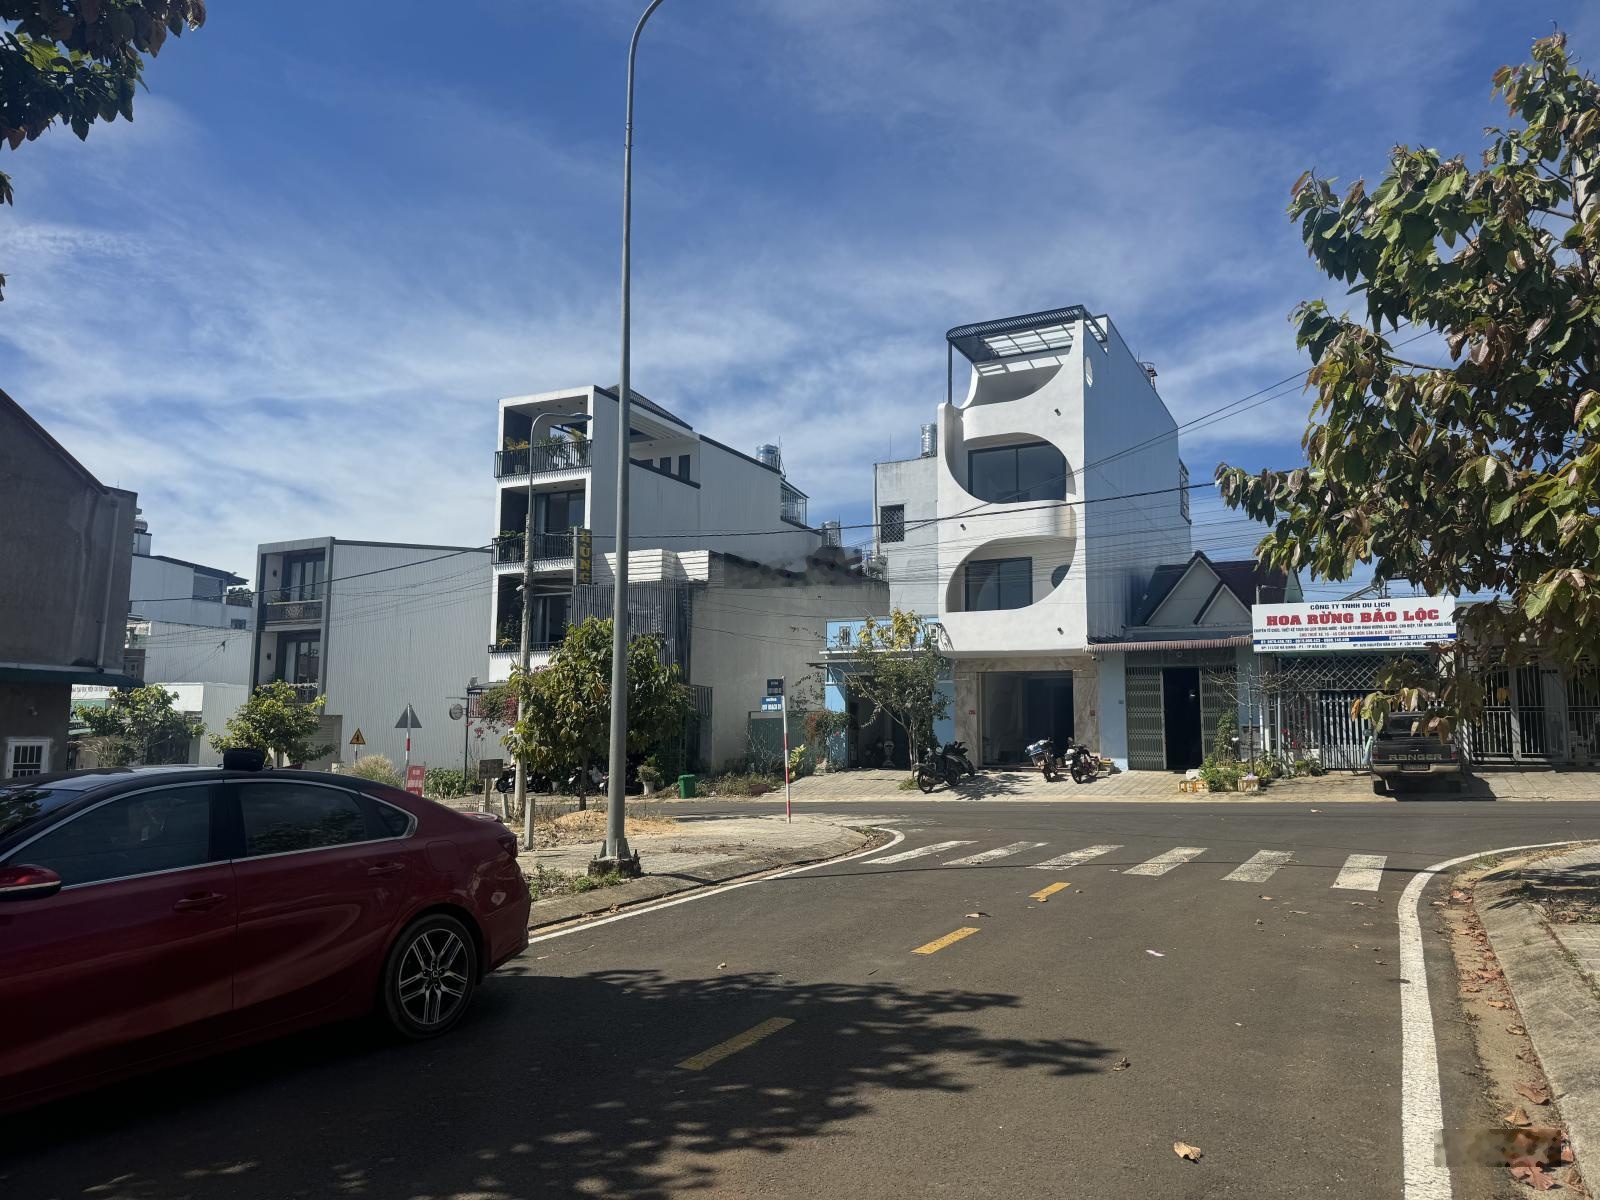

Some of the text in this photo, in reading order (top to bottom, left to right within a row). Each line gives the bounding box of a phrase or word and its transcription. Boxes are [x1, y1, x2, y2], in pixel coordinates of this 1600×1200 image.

[1266, 608, 1439, 626] HOA RỪNG BẢO LỘC
